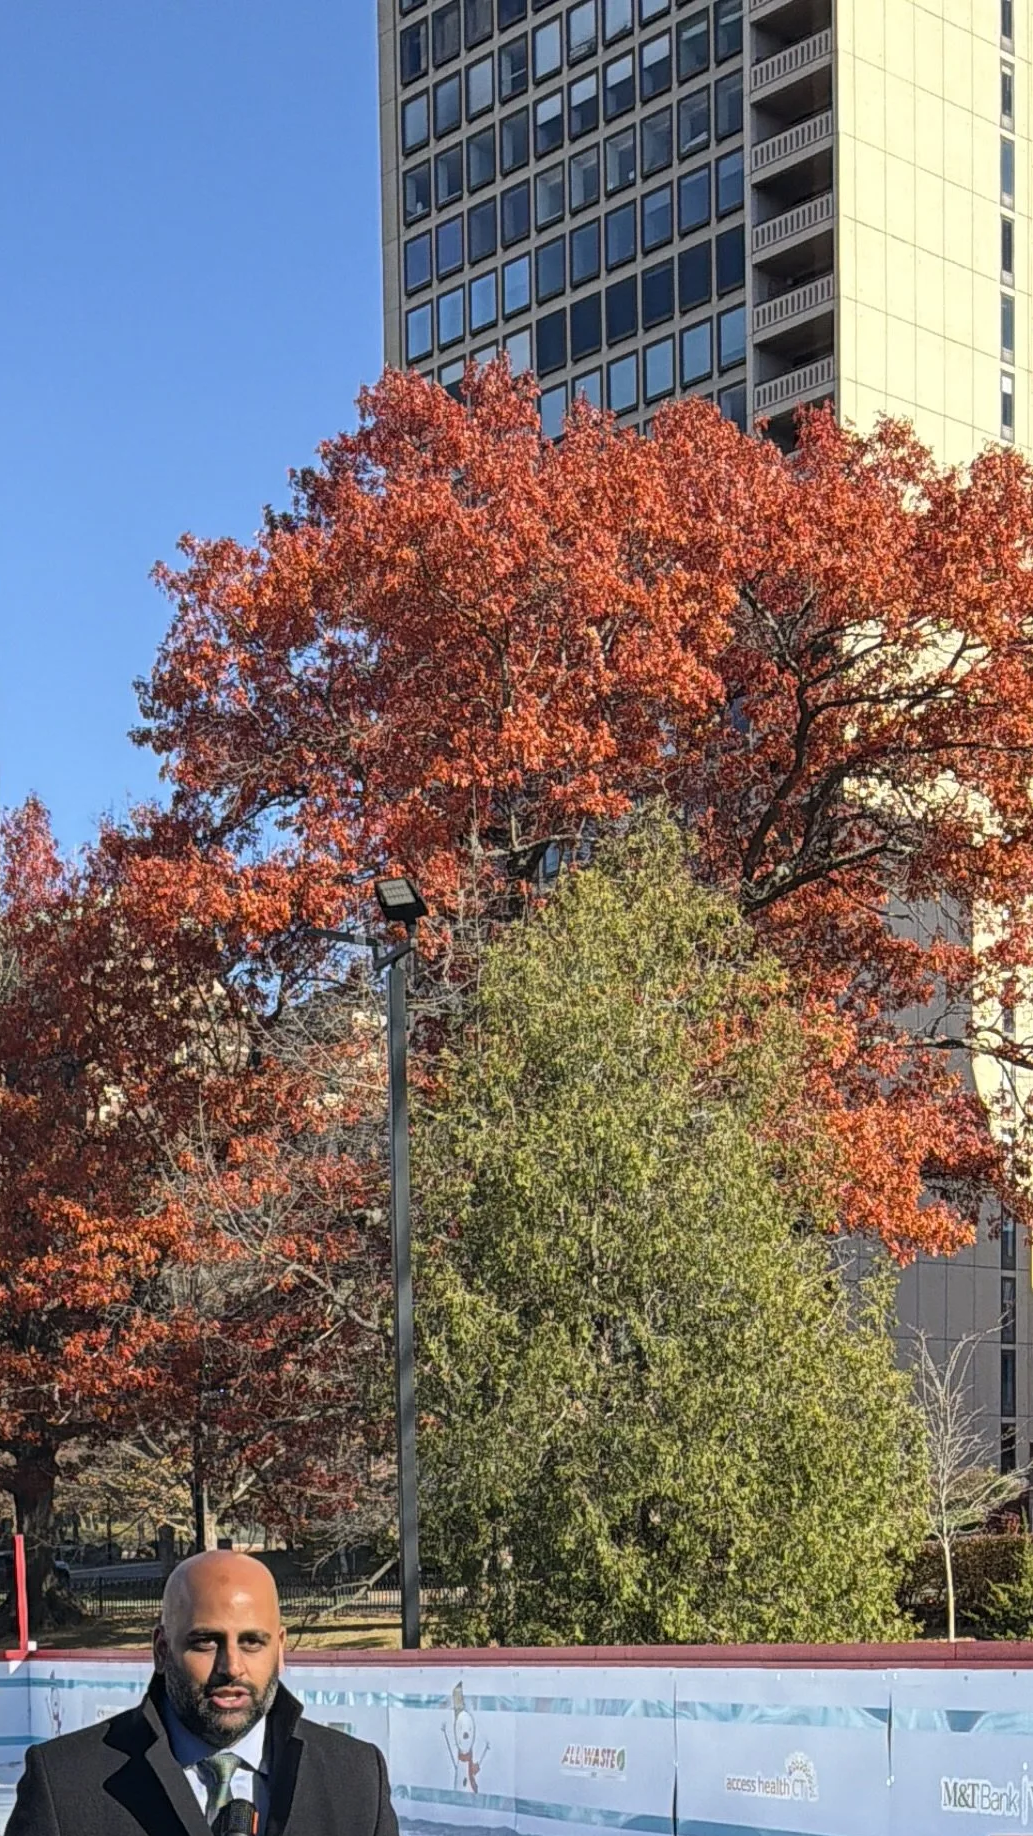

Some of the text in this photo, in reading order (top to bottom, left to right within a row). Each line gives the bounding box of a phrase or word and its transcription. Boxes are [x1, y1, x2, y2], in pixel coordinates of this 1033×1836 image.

[561, 1744, 616, 1769] ALL WASTE
[726, 1777, 757, 1793] access
[757, 1776, 790, 1796] health
[942, 1781, 980, 1809] M&T
[980, 1783, 1019, 1813] Bank
